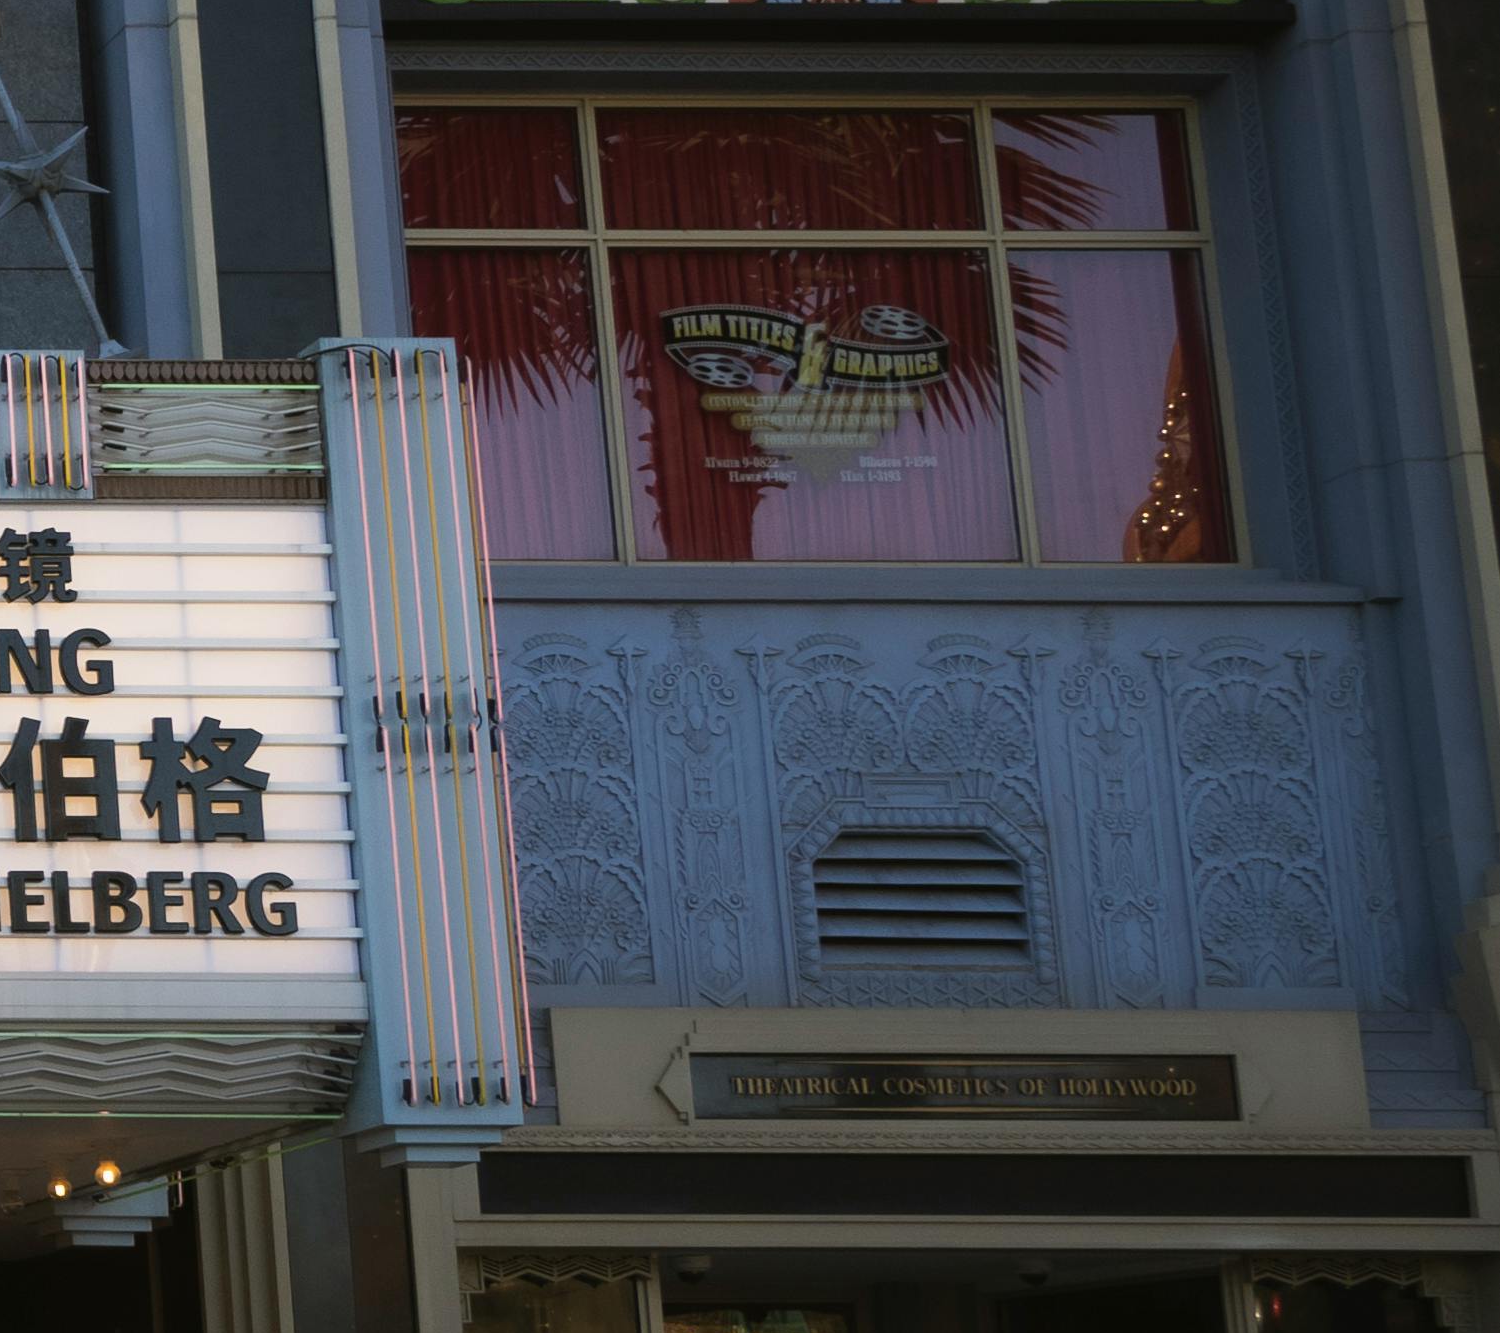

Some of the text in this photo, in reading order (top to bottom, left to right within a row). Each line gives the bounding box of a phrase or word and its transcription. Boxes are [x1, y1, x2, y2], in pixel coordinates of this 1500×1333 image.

[672, 315, 722, 339] FILM
[725, 315, 797, 351] TITLES
[832, 346, 940, 377] GRAPHICS
[732, 1076, 1196, 1097] THEATRICAL COSMETICS OF HOLLYWOOD
